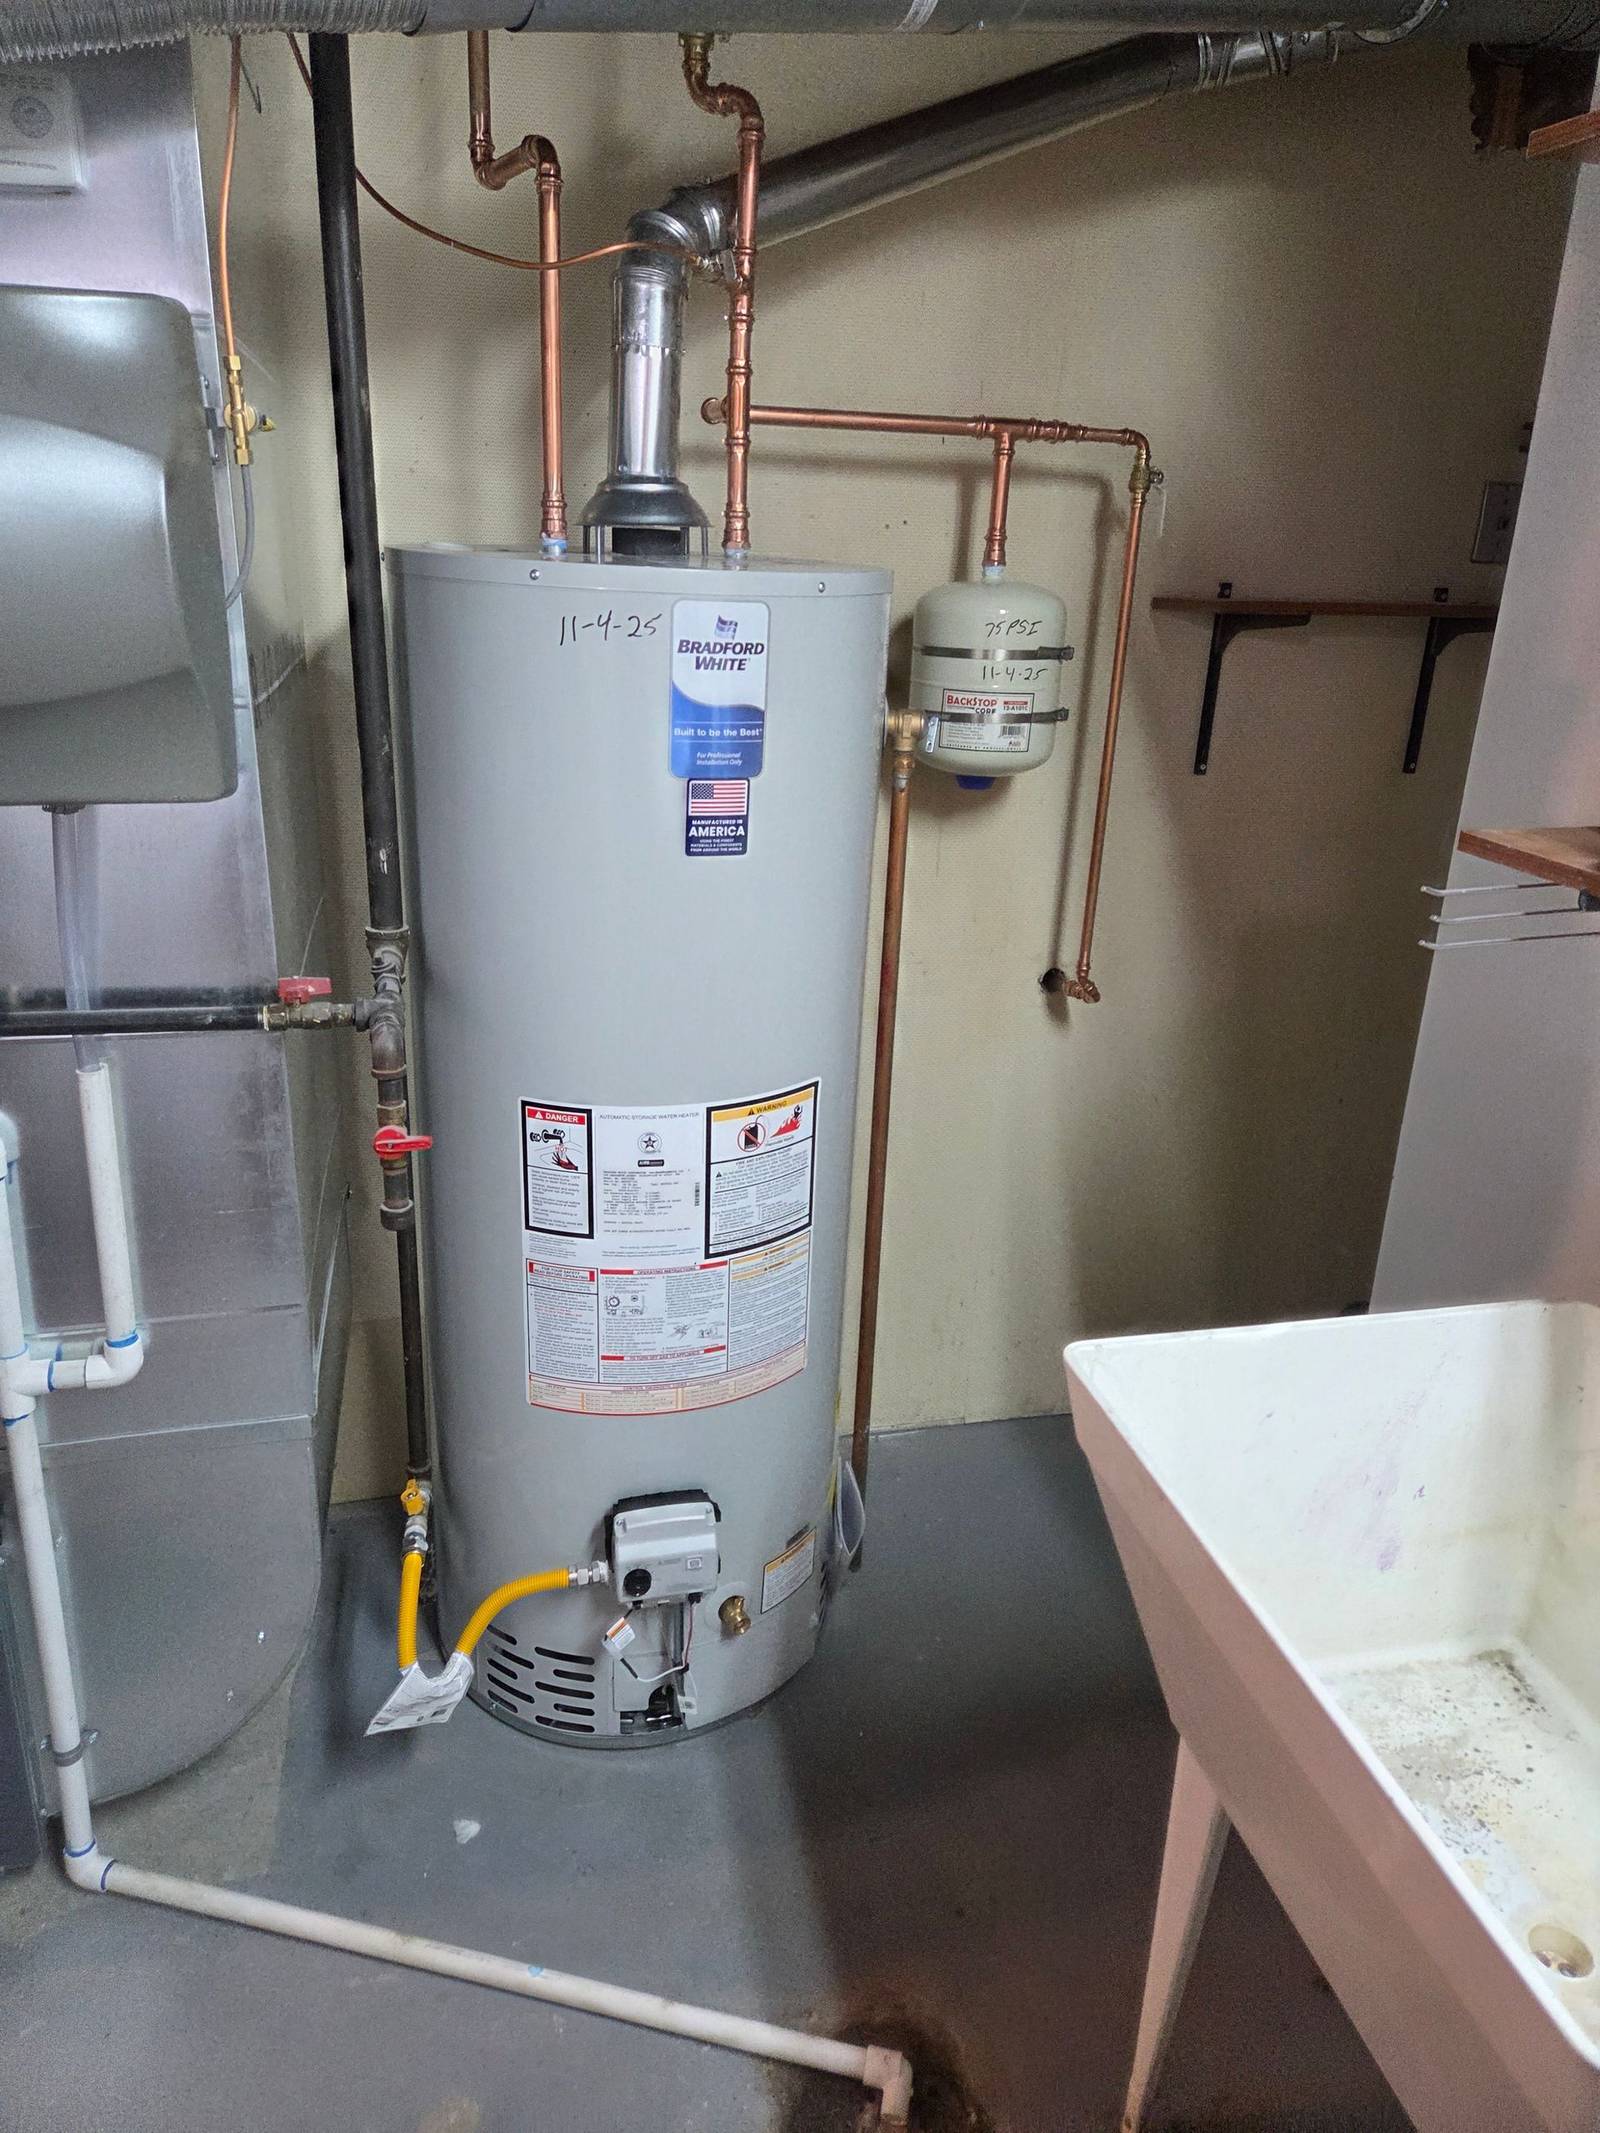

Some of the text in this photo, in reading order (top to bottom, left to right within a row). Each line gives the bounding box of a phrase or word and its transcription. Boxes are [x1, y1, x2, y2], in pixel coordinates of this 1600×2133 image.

[559, 609, 663, 646] 11-4-25
[677, 639, 765, 656] BRADFORD
[694, 656, 747, 671] WHITE
[946, 694, 998, 707] BACKSTOP
[674, 727, 760, 737] Built to be the Best
[688, 826, 745, 837] AMERICA
[756, 1101, 787, 1113] WARNING
[545, 1112, 579, 1123] DANGER
